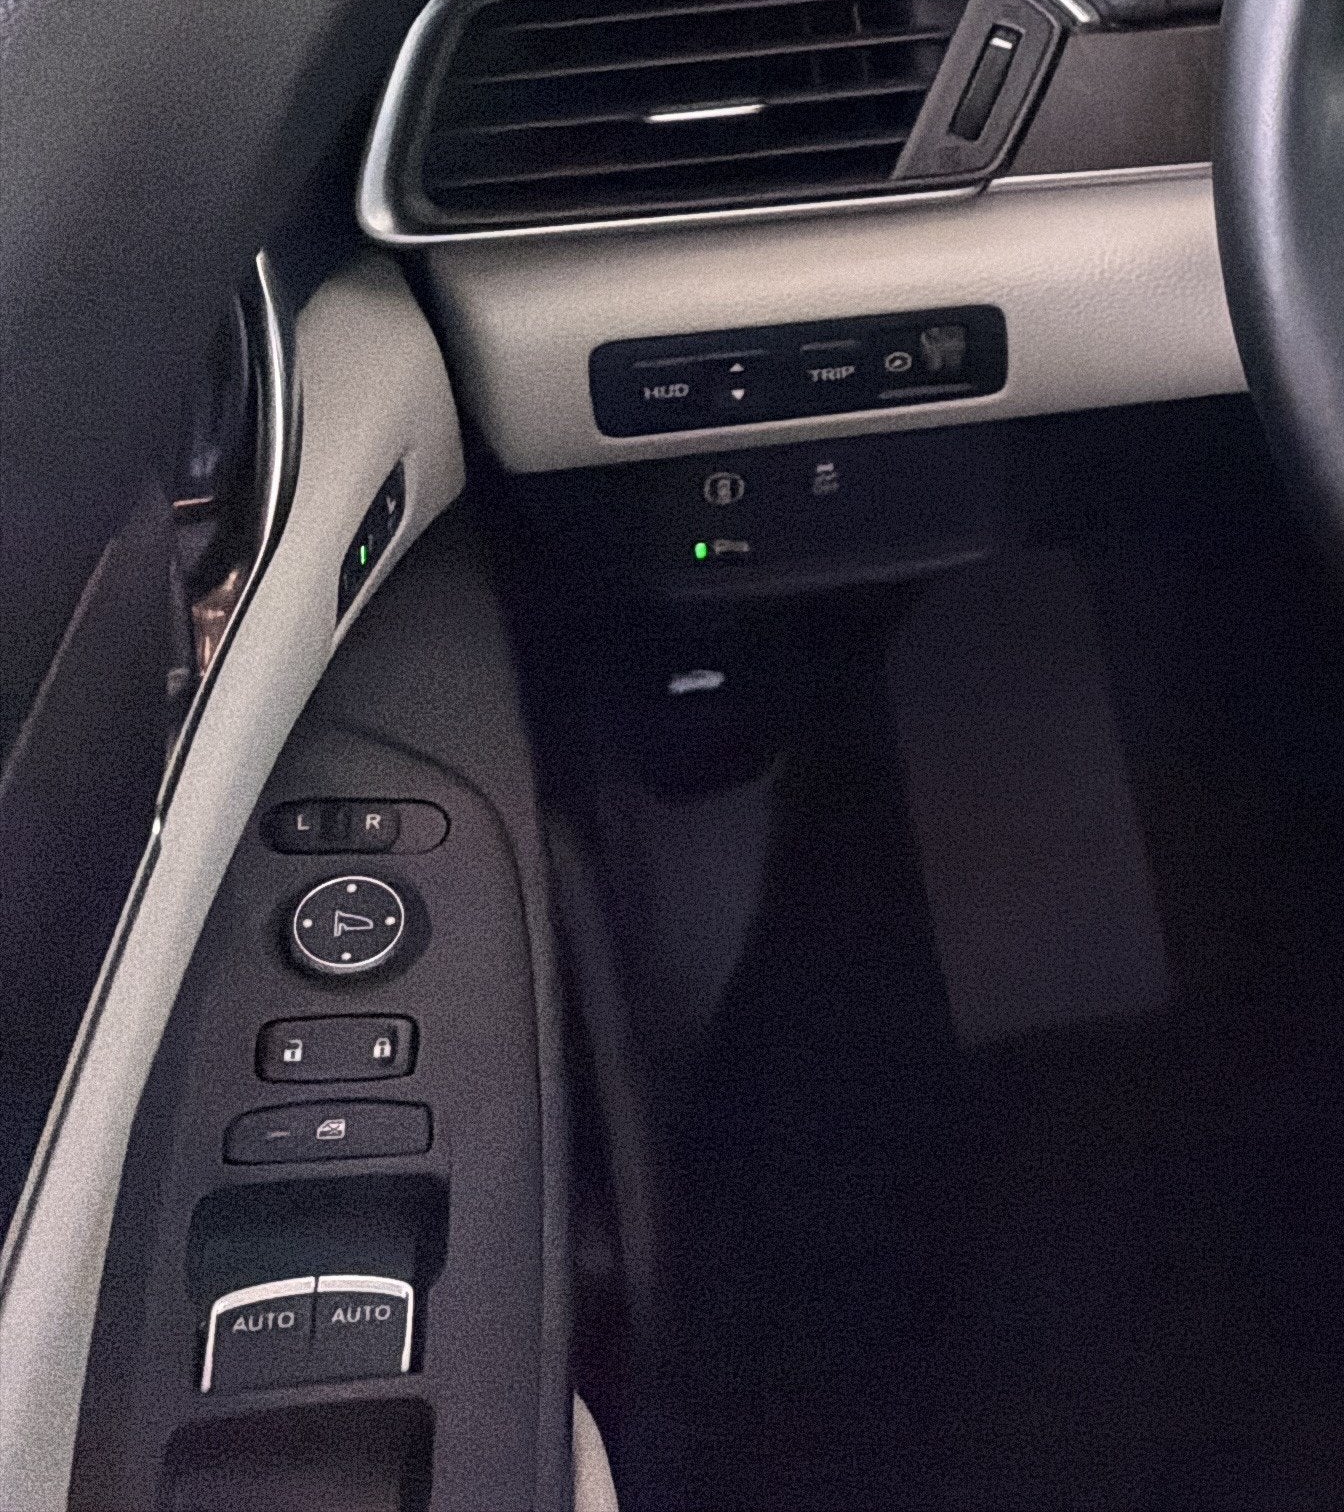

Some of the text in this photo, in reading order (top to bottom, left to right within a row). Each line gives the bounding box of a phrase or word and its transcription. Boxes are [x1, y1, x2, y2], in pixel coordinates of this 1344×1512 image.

[809, 366, 855, 382] TRIP
[644, 383, 690, 400] HUD
[297, 815, 309, 831] L
[365, 813, 381, 830] R
[232, 1311, 295, 1332] AUTO
[331, 1304, 391, 1323] AUTO
